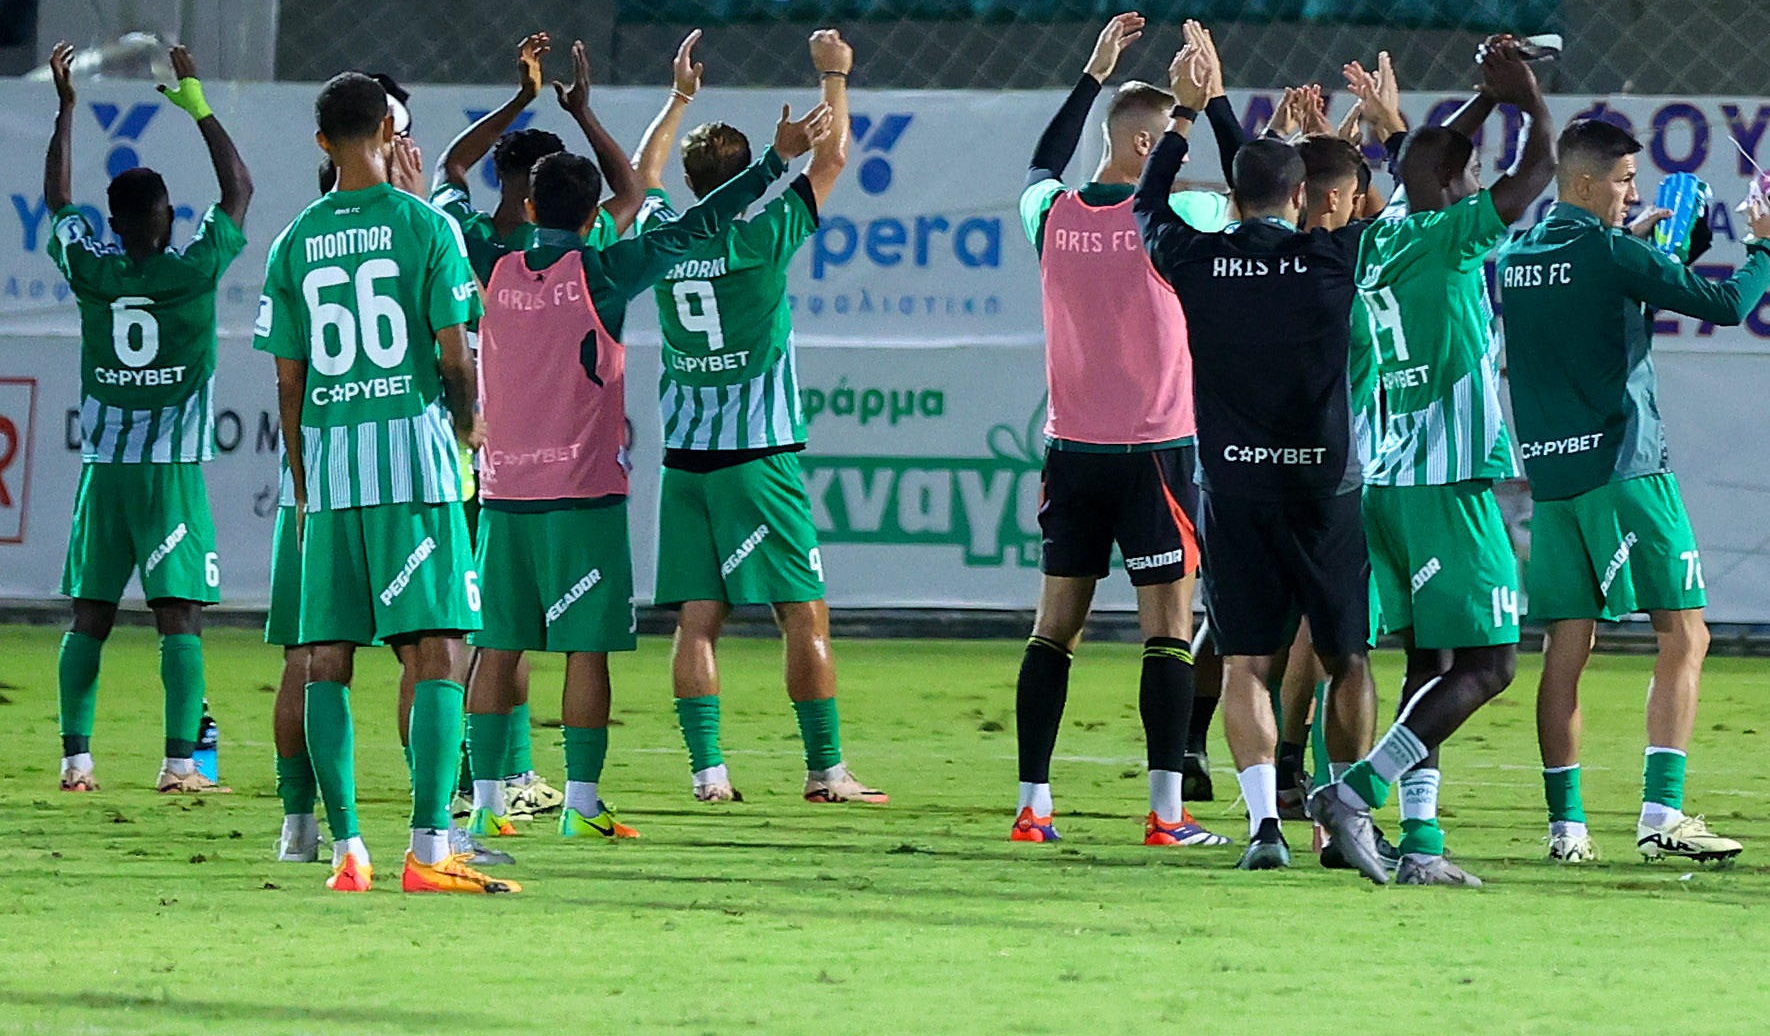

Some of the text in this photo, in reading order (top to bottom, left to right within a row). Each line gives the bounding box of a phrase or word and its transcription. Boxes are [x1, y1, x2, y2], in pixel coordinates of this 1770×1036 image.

[305, 225, 393, 263] MONTNOR
[810, 215, 1002, 281] pera
[1055, 229, 1138, 252] ARIS FC
[552, 280, 581, 306] FC
[1503, 262, 1572, 288] ARIS FC
[109, 296, 161, 367] 6
[302, 257, 409, 376] 66
[672, 279, 725, 352] 9
[204, 551, 220, 588] 6
[379, 535, 438, 607] PEGADOR
[808, 547, 825, 582] 9
[1491, 585, 1520, 628] 14
